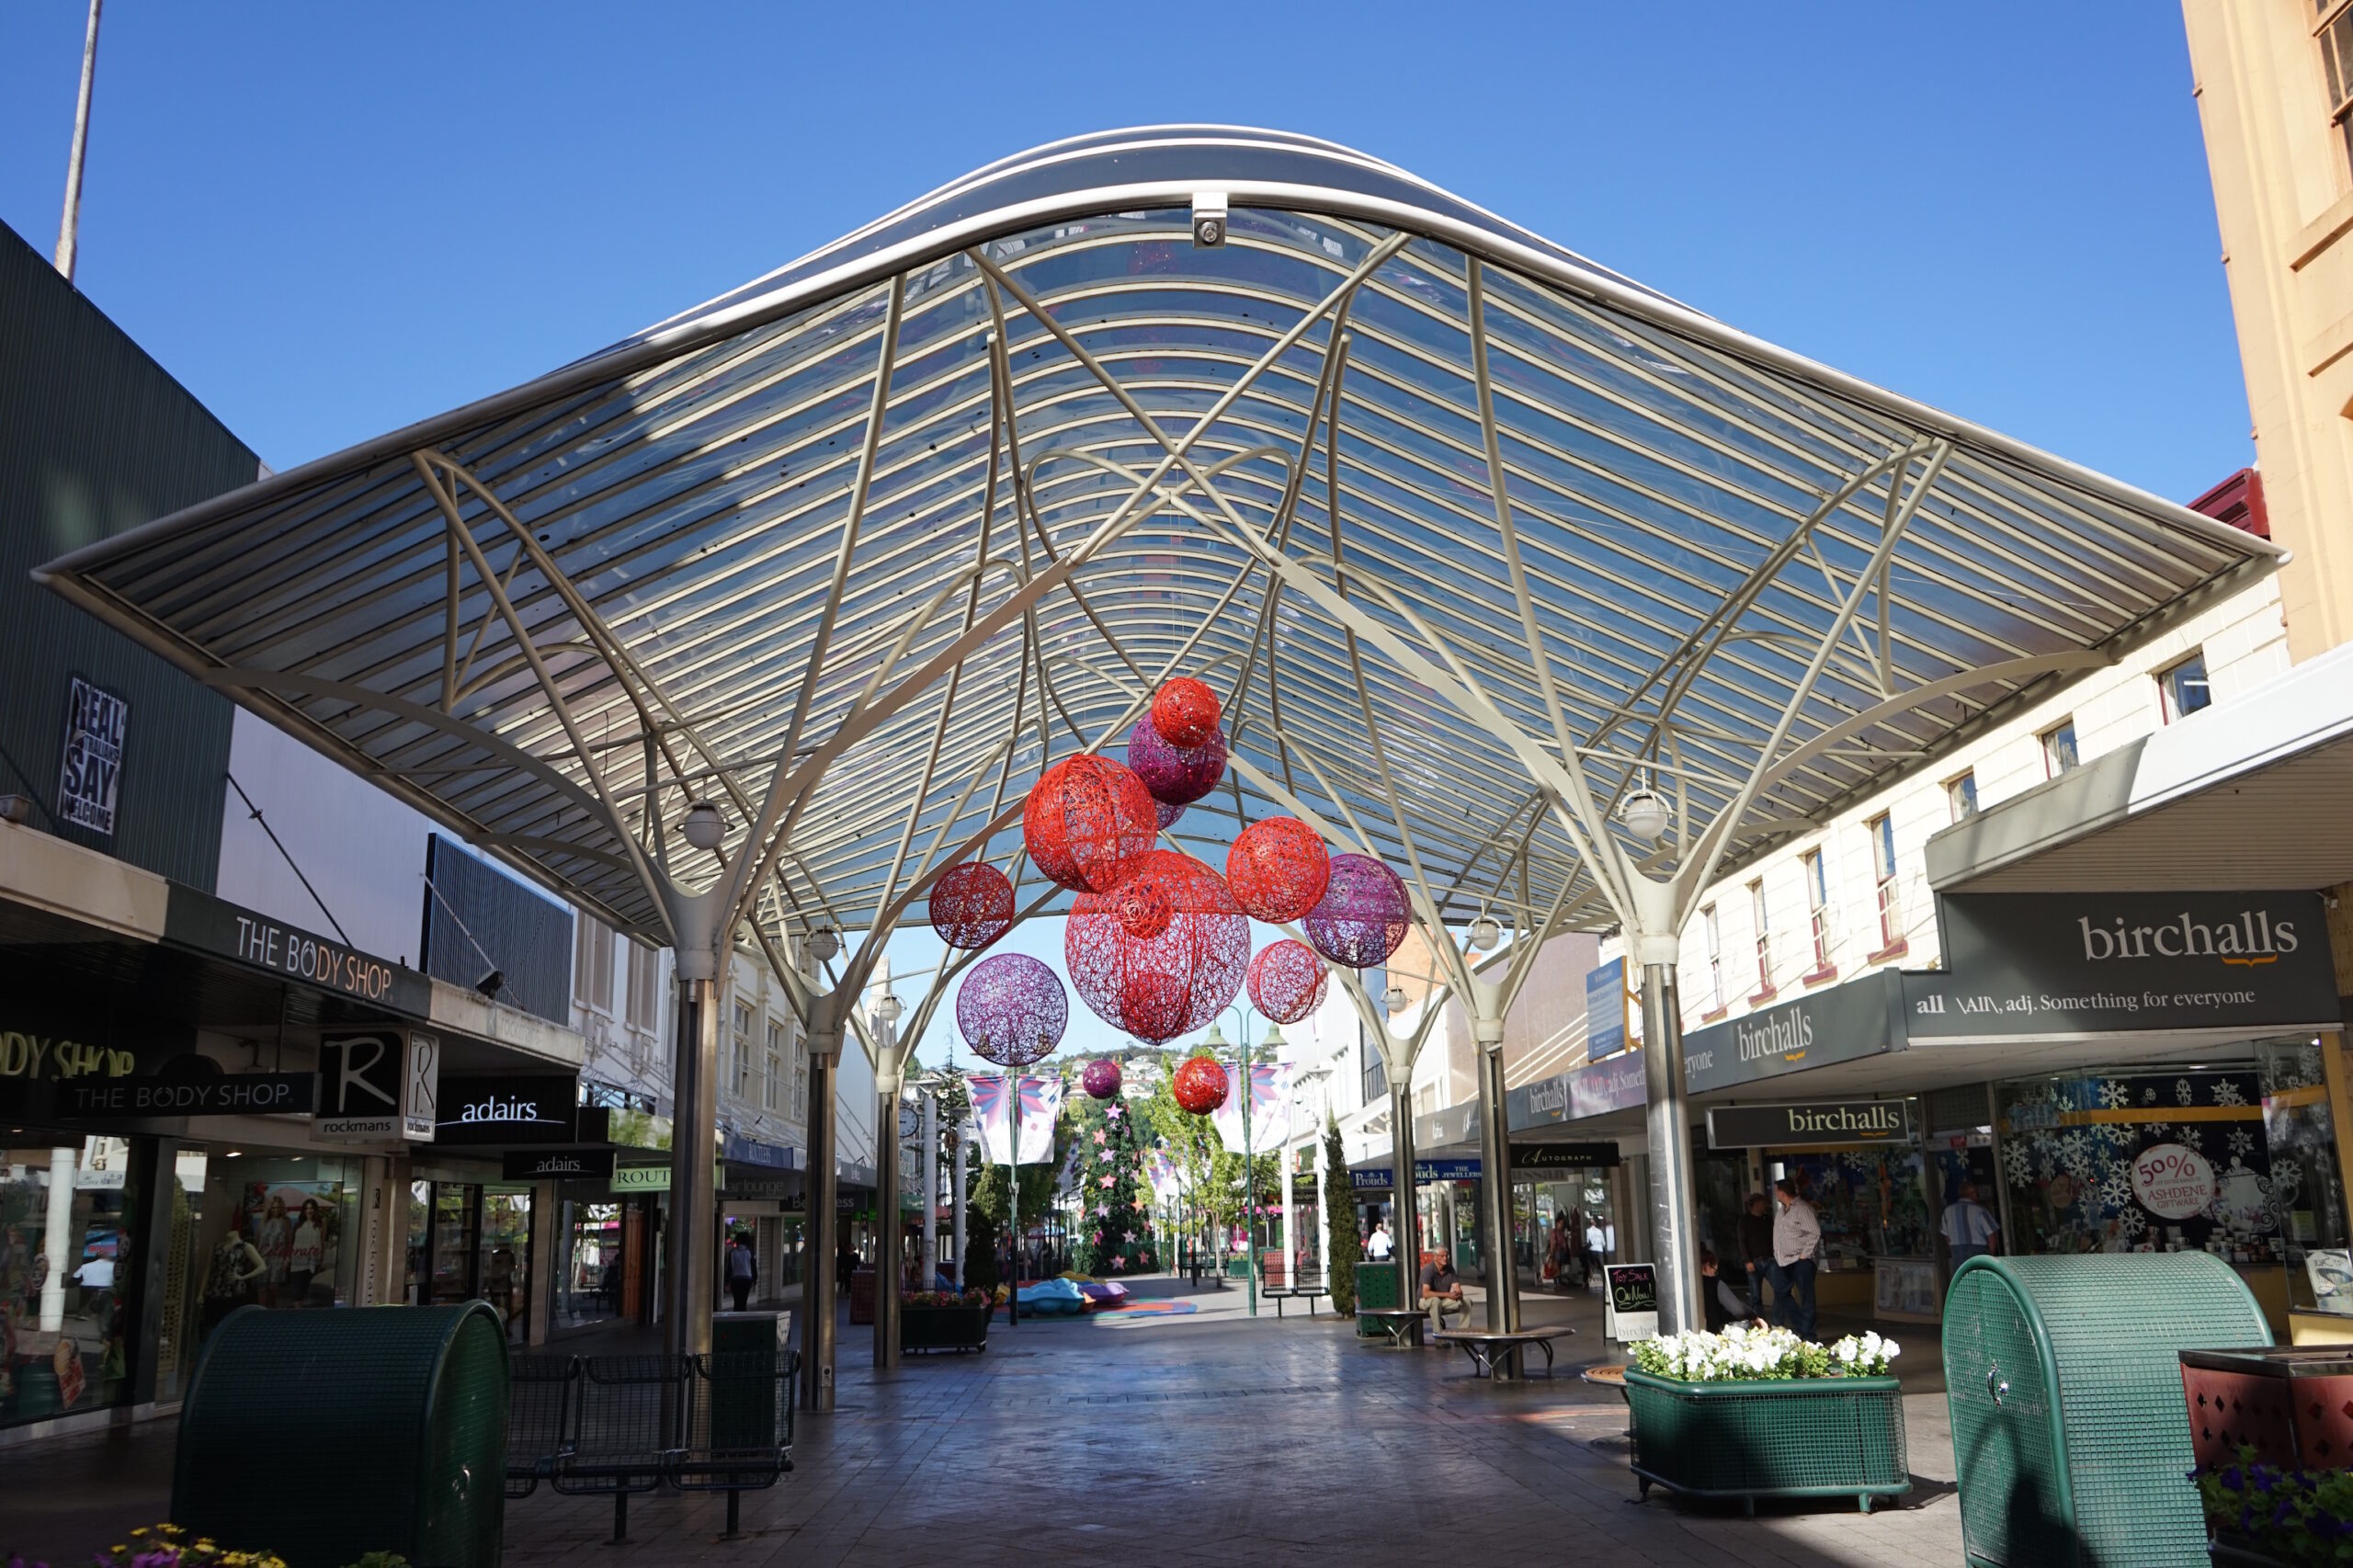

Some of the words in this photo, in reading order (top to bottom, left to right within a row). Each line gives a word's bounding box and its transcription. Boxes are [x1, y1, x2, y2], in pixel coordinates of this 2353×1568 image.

[64, 745, 117, 807] SAY
[64, 793, 112, 832] WELCOME
[2077, 910, 2298, 961] birchalls
[236, 915, 280, 967] THE
[286, 934, 344, 986] BODY
[345, 955, 392, 1001] SHOP
[1916, 994, 1946, 1014] all
[2006, 994, 2038, 1016] adj.
[2040, 993, 2139, 1012] Something
[2143, 991, 2168, 1007] for
[2174, 990, 2256, 1009] everyone
[1737, 1005, 1813, 1062] birchalls
[324, 1036, 397, 1114] R
[74, 1088, 126, 1108] THE
[136, 1085, 212, 1108] BODY
[218, 1083, 290, 1106] SHOP
[461, 1094, 538, 1121] adairs
[1529, 1078, 1563, 1115] birchalls
[324, 1120, 391, 1133] rockmans
[1788, 1106, 1901, 1132] birchalls
[536, 1155, 581, 1172] adairs
[617, 1169, 671, 1184] ROUT
[2138, 1153, 2196, 1186] 50%
[744, 1178, 785, 1196] lounge
[1355, 1171, 1388, 1187] Prouds
[2148, 1185, 2208, 1201] ASHDENE
[2157, 1198, 2200, 1209] GIFTWARE
